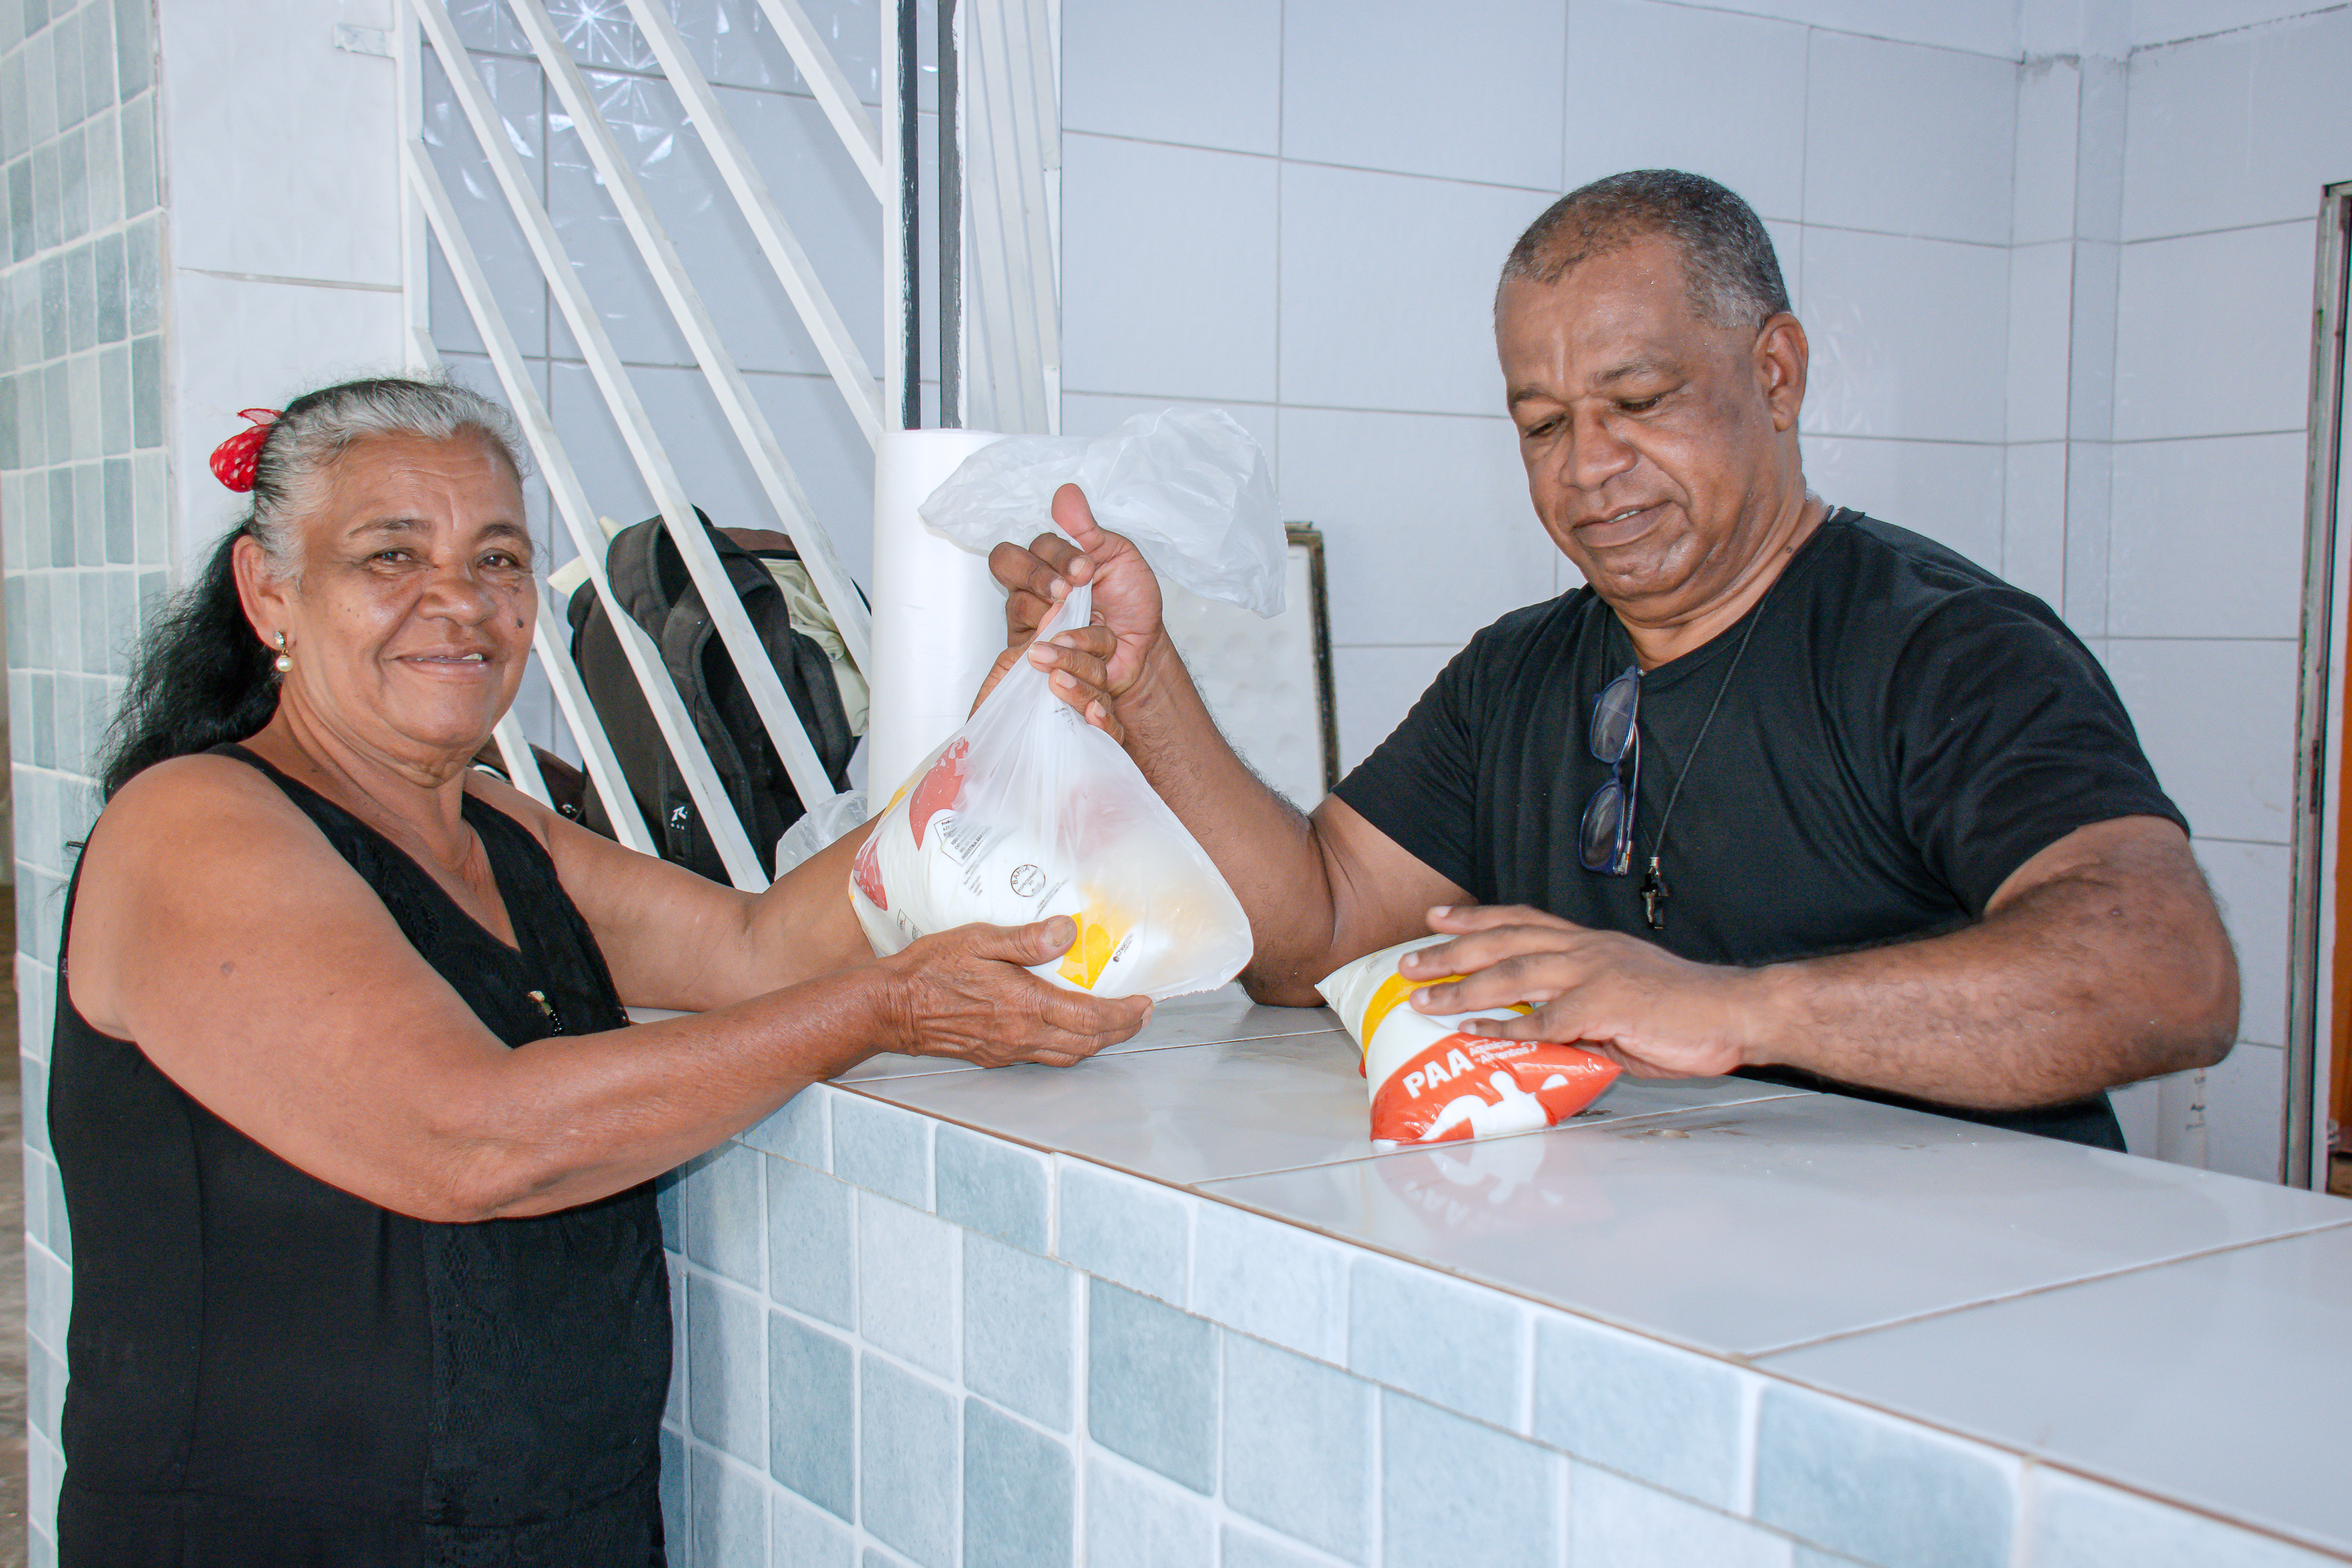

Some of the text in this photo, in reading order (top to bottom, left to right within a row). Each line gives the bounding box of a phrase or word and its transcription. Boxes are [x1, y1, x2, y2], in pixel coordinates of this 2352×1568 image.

[1012, 866, 1030, 885] BAHIA
[1469, 1040, 1516, 1057] Aquisição
[1402, 1048, 1475, 1099] PAA
